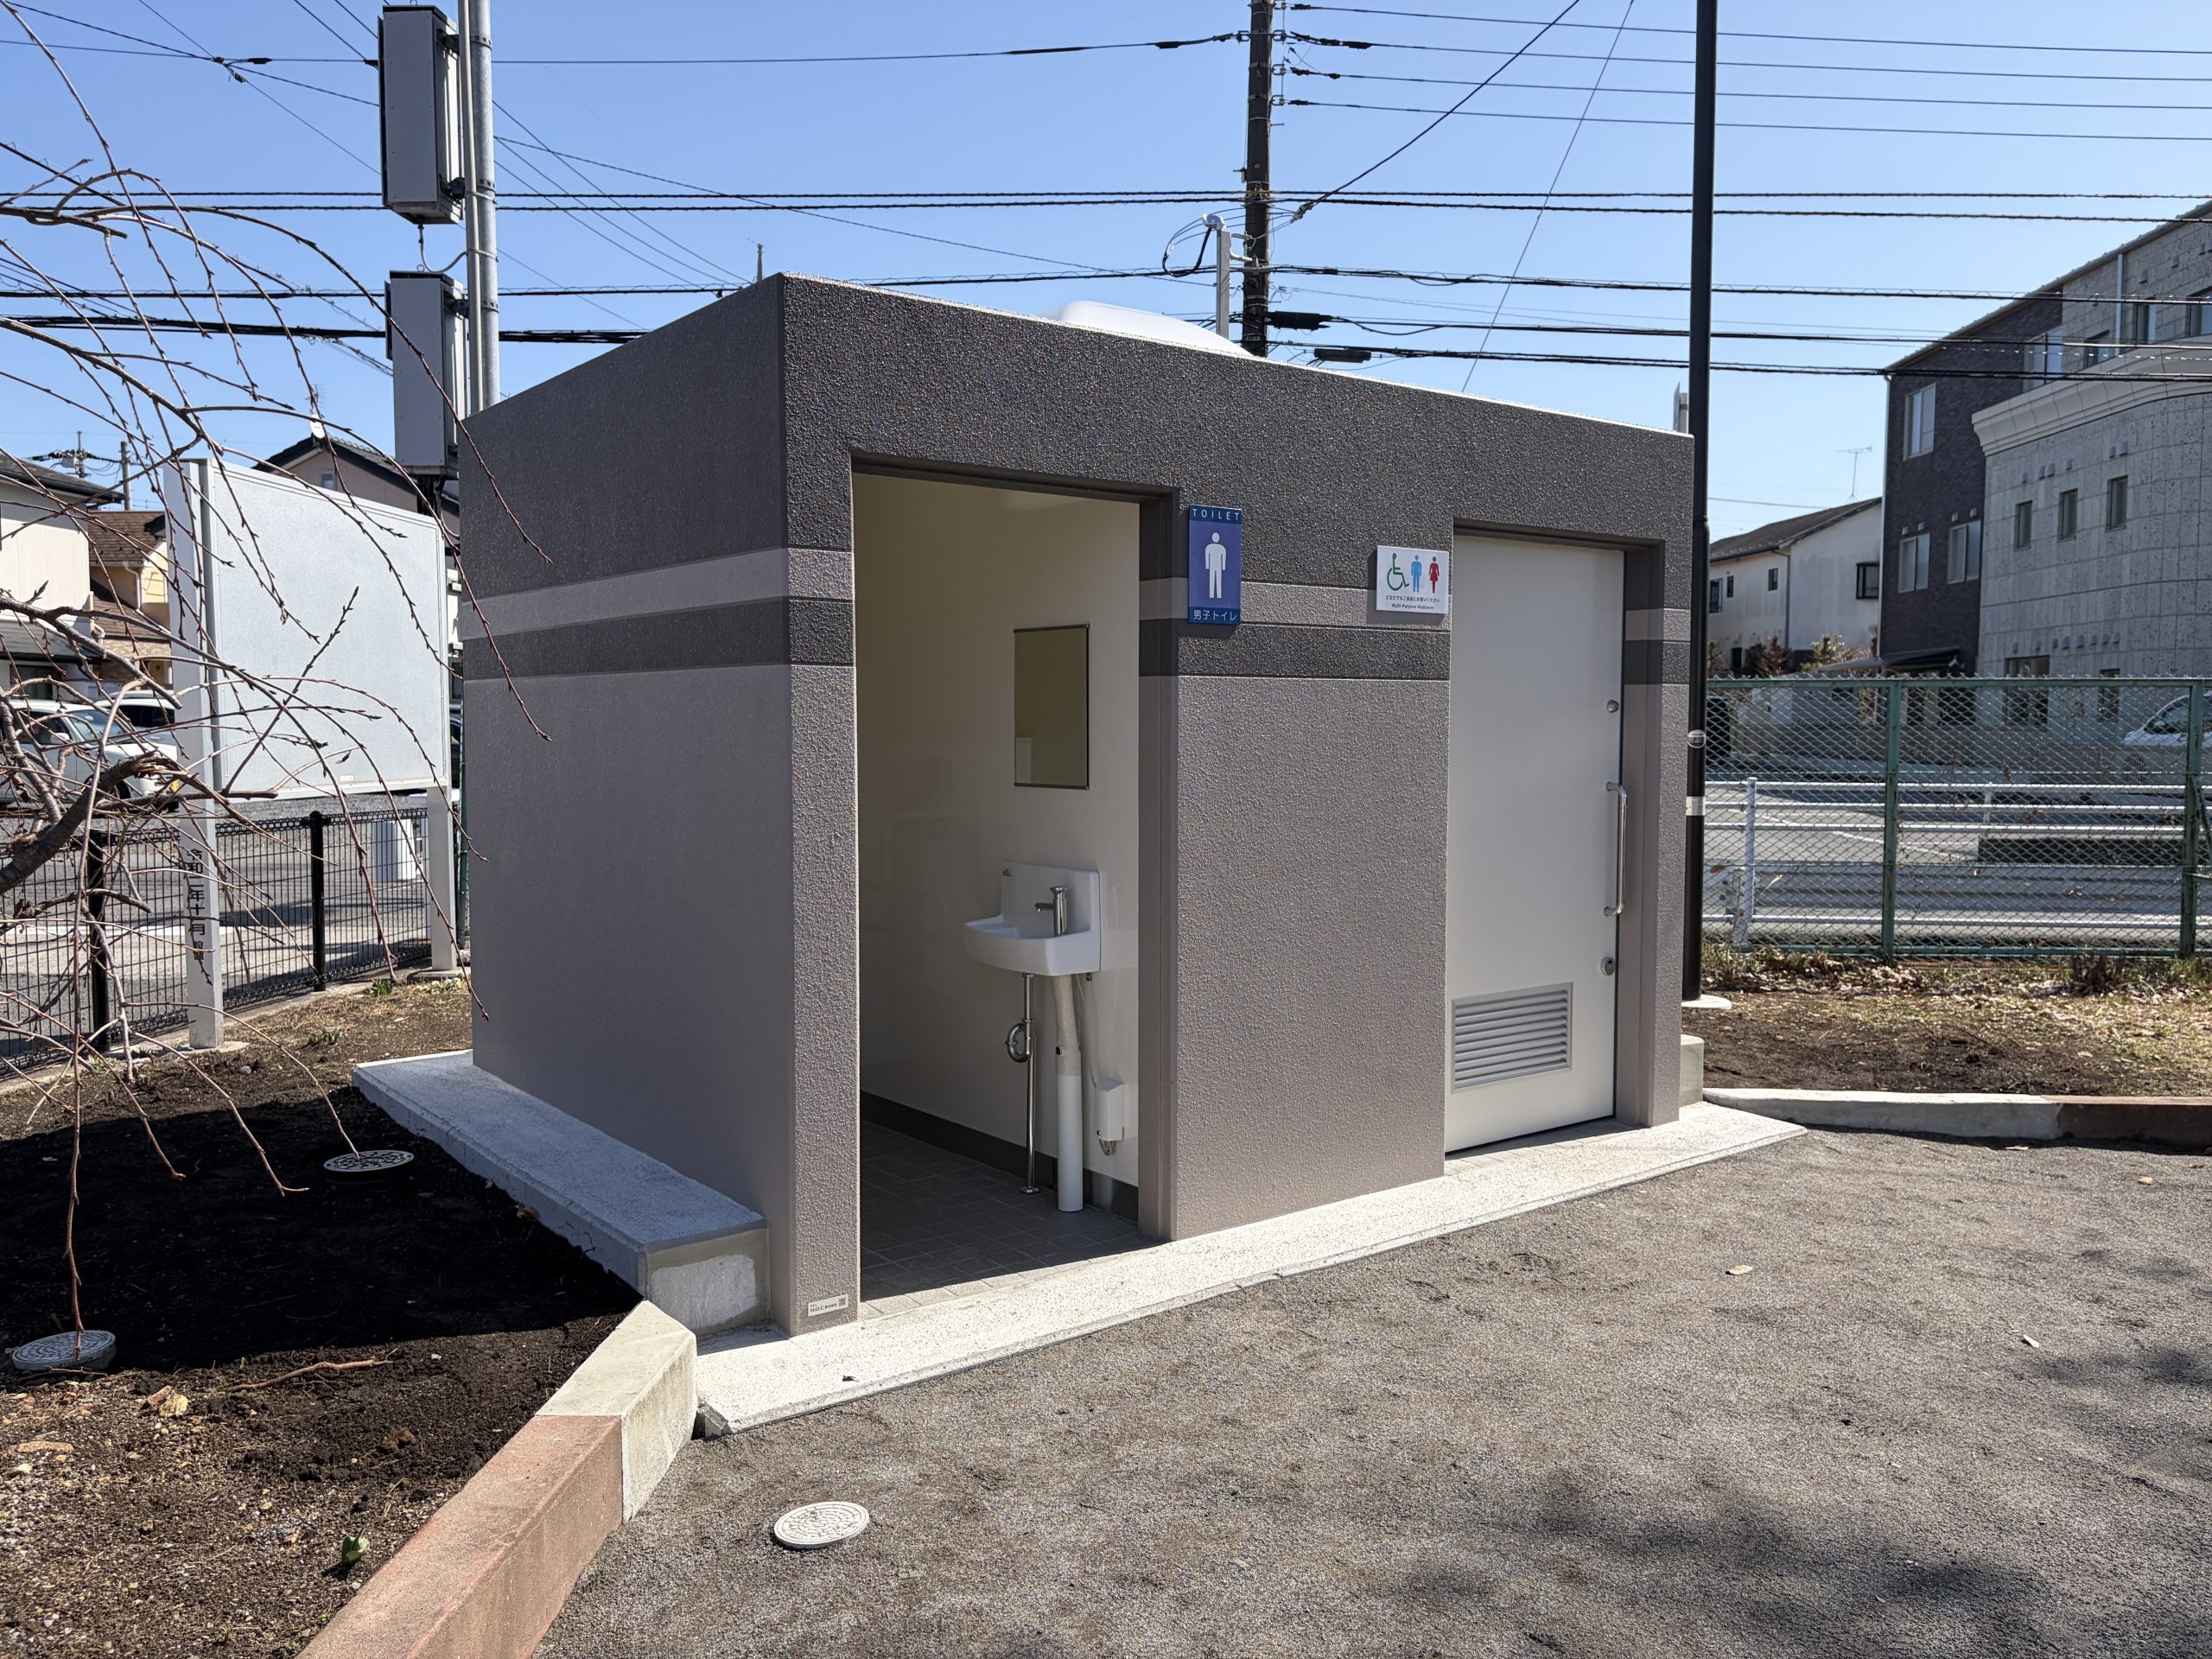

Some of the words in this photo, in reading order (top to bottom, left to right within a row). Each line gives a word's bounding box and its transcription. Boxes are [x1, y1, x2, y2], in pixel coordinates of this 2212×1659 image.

[1192, 509, 1239, 520] TOILET
[1193, 609, 1237, 621] 男子トイレ
